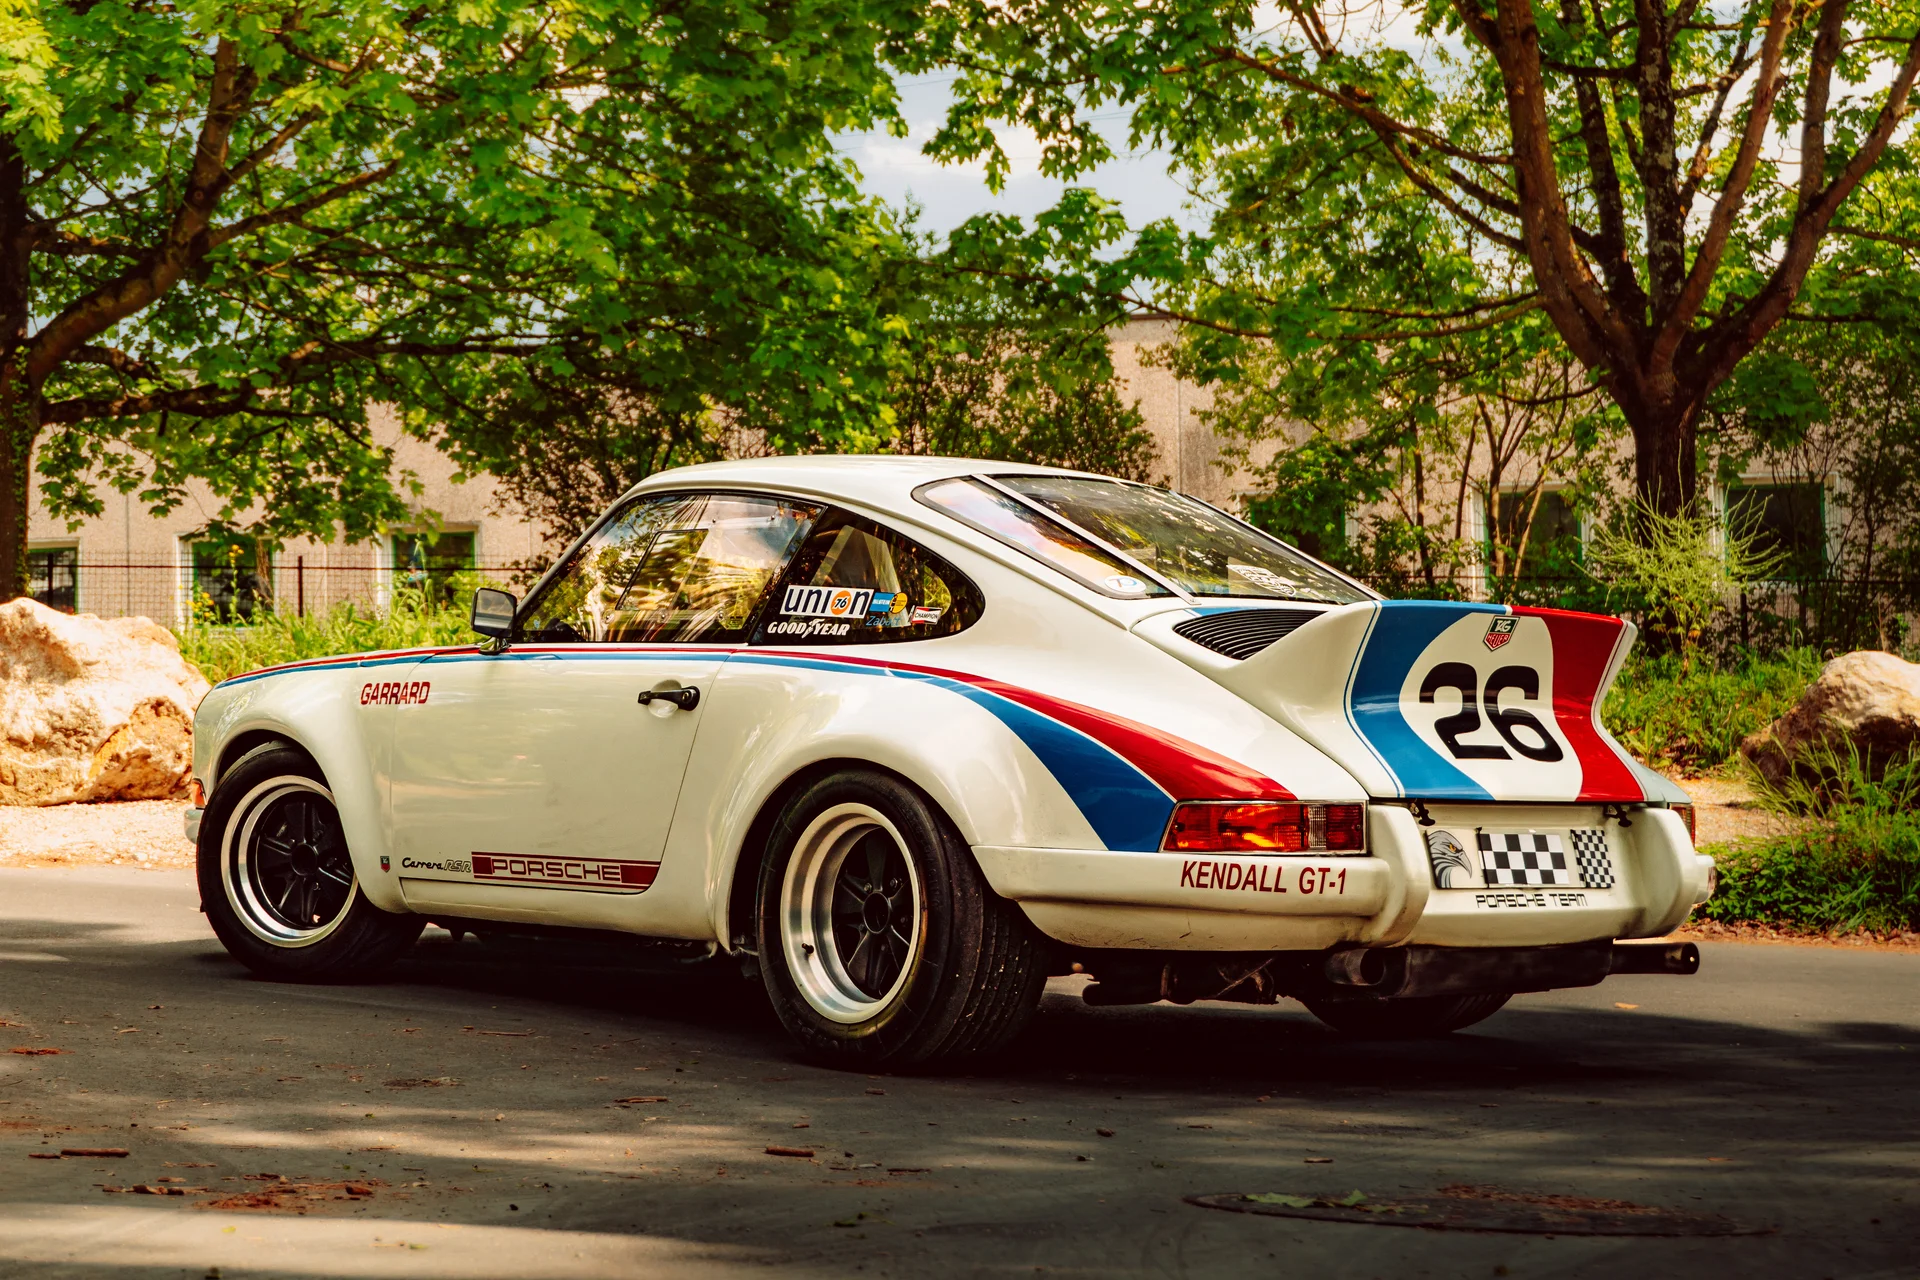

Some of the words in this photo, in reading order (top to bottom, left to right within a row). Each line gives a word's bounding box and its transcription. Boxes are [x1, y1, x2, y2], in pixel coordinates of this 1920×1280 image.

[833, 597, 847, 609] 76
[1495, 620, 1512, 632] TAG
[1486, 634, 1510, 647] HEUER
[360, 681, 431, 705] GARRARD
[1419, 662, 1564, 762] 26
[401, 857, 445, 870] Carrera
[492, 858, 621, 882] PORSCHE
[1180, 860, 1287, 893] KENDALL
[1299, 866, 1347, 895] GT-1
[1475, 893, 1546, 908] PORSCHE
[1549, 893, 1588, 907] TEAM
